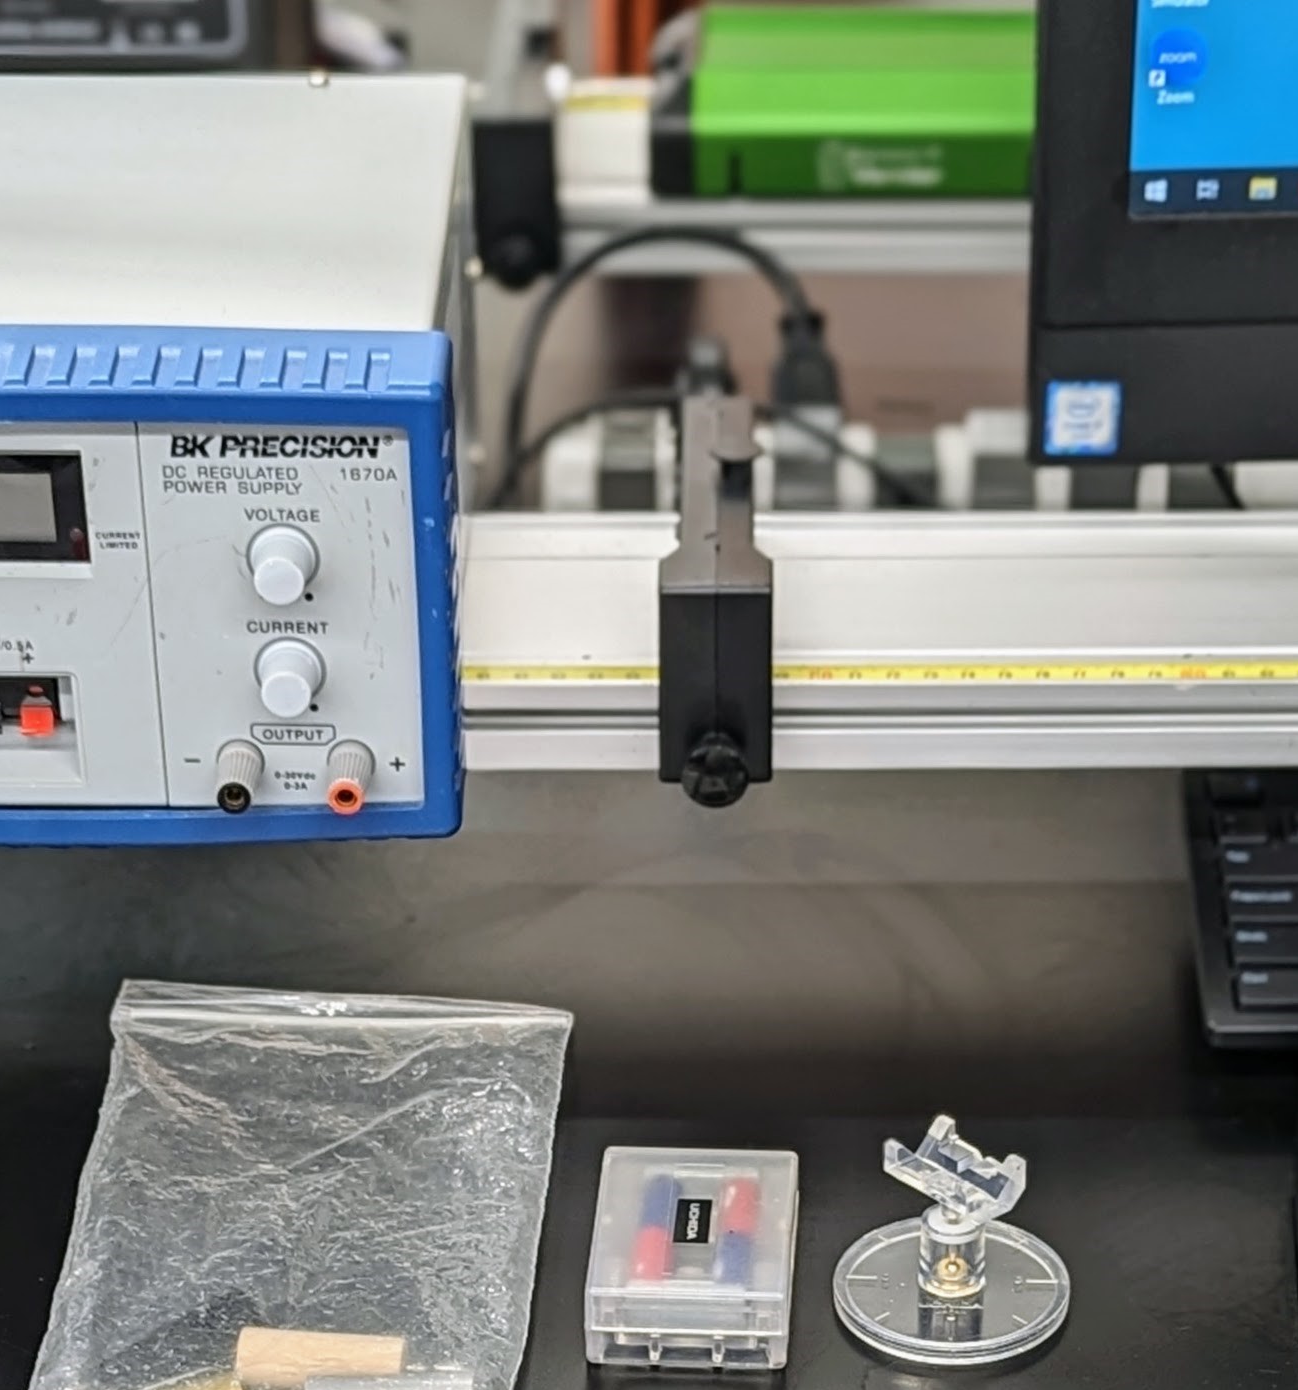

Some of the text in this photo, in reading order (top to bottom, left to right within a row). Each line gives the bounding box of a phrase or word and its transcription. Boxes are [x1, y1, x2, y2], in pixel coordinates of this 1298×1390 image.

[162, 465, 299, 481] DC REGULATED
[163, 481, 303, 496] POWER SUPPLY
[244, 508, 321, 523] VOLTAGE
[246, 621, 329, 636] CURRENT
[262, 728, 325, 742] OUTPUT
